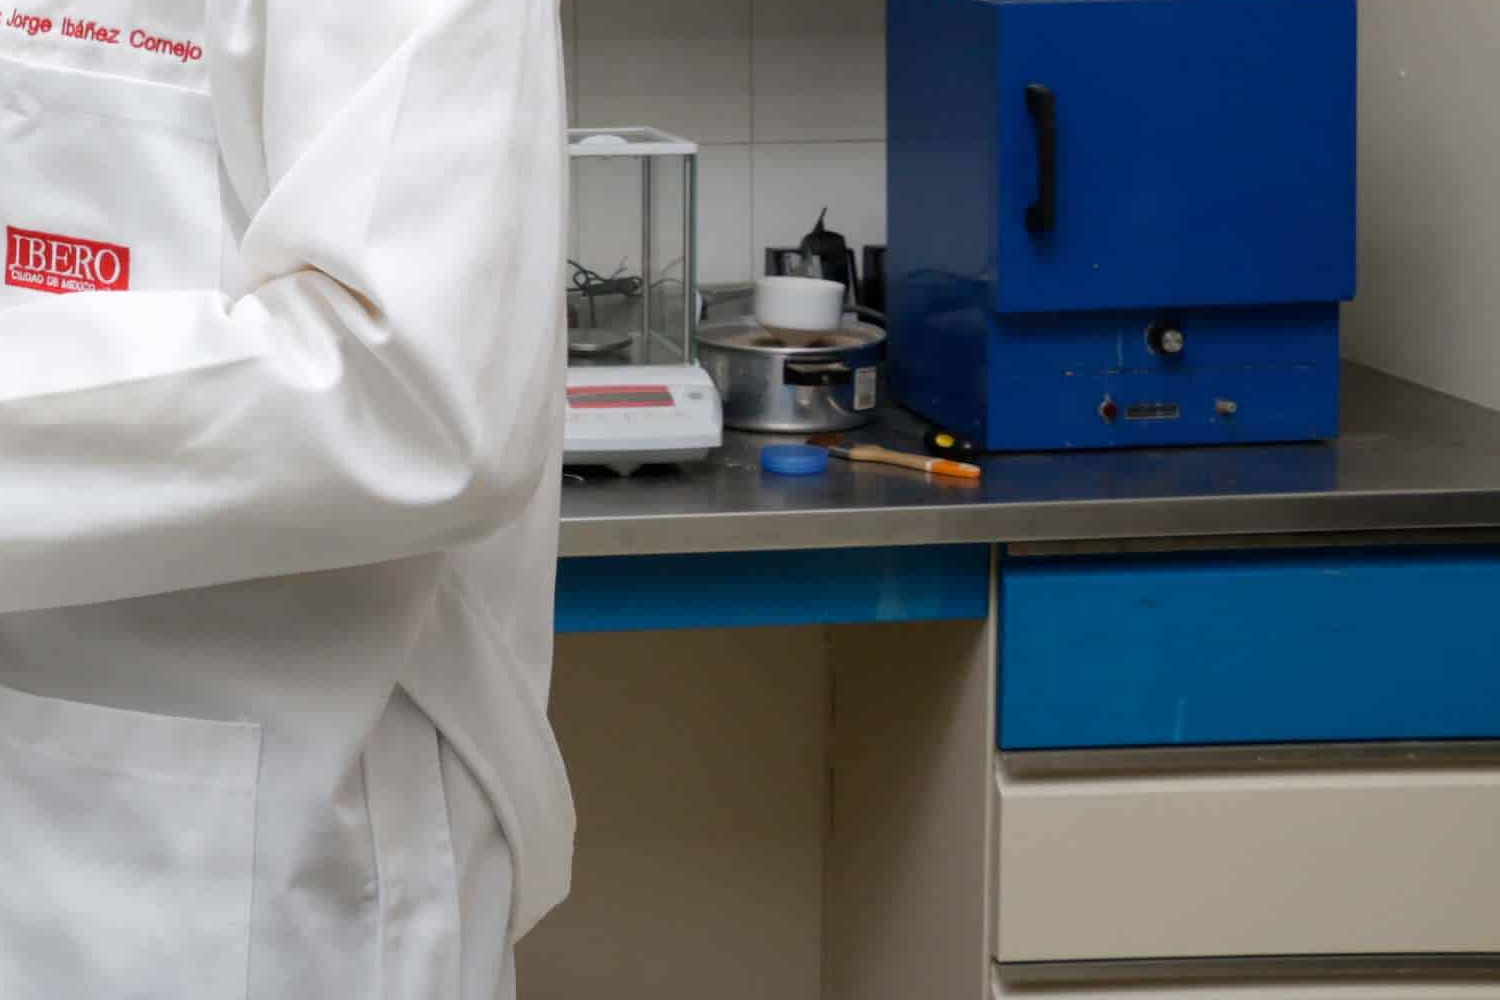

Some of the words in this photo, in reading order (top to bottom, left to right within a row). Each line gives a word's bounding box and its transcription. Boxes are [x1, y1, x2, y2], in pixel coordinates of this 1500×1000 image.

[6, 7, 52, 36] Jorge
[61, 16, 121, 44] Ibáñez
[129, 29, 203, 62] Cornejo
[9, 233, 122, 285] IBERO
[11, 270, 44, 285] CIUDAD
[46, 276, 59, 287] DE
